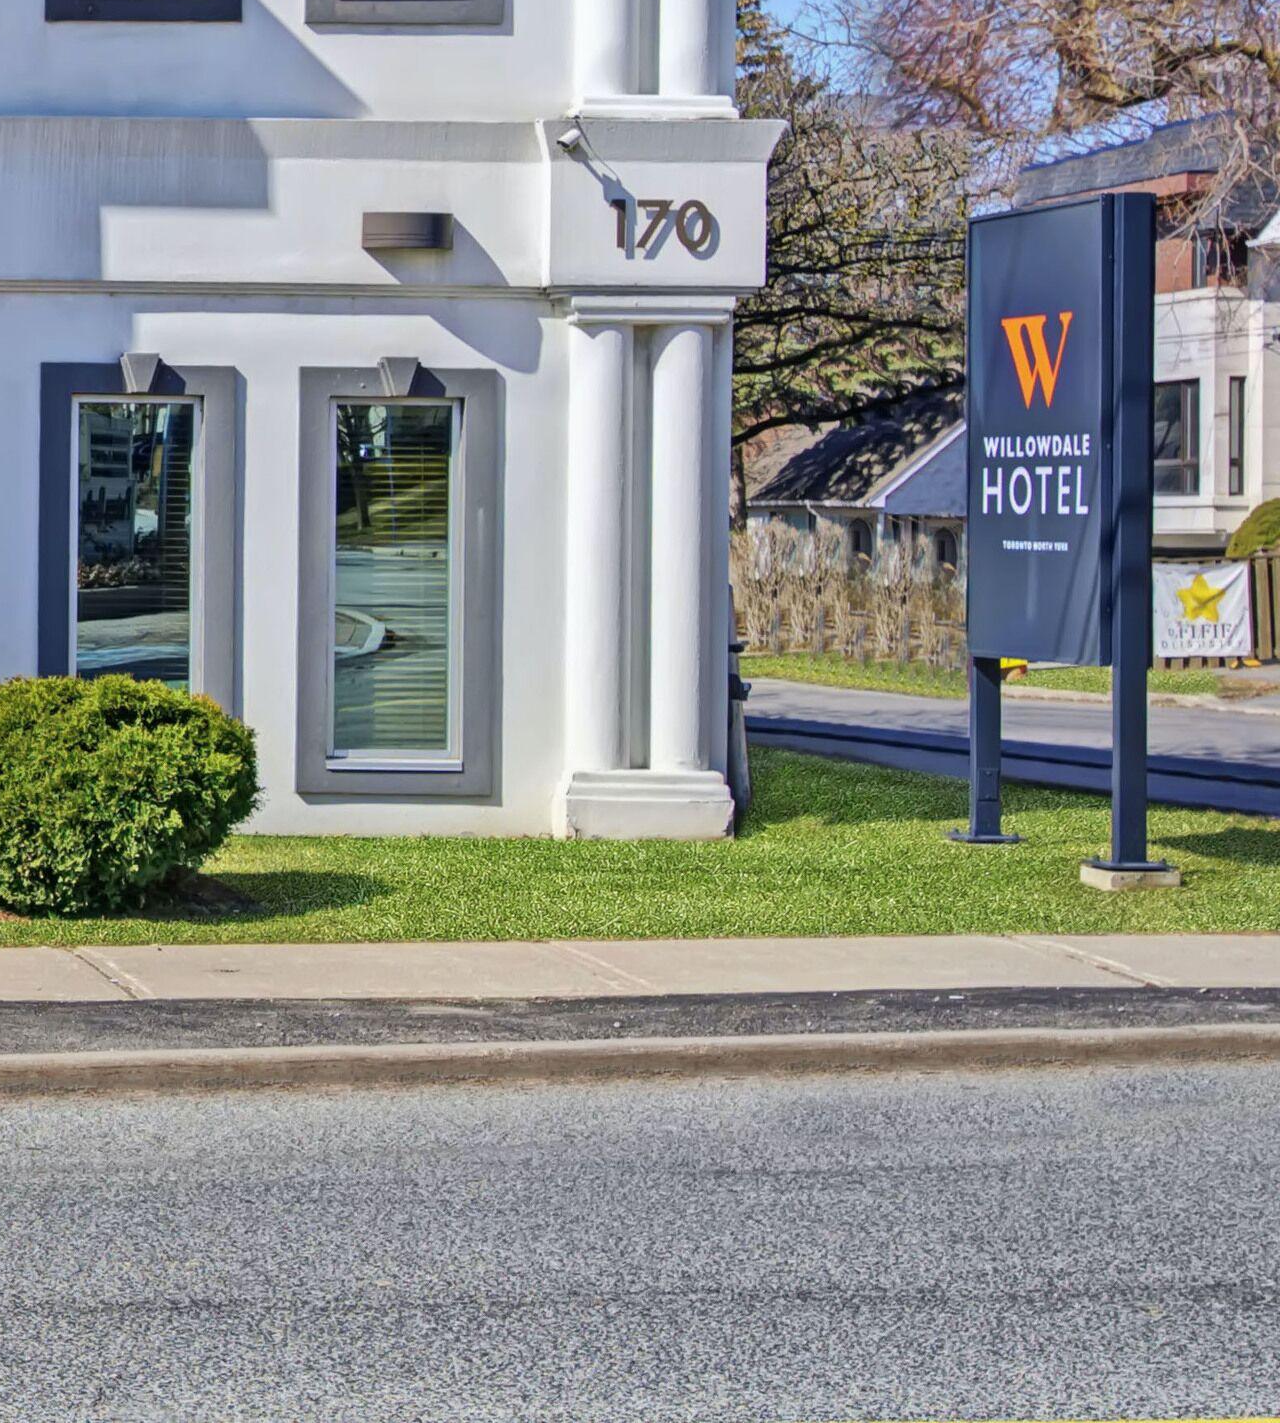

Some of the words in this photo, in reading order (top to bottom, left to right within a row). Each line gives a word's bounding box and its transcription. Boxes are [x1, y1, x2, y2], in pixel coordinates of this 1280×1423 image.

[609, 198, 712, 252] 170
[1001, 311, 1073, 410] W
[983, 433, 1090, 458] WILLOWDALE
[982, 465, 1089, 515] HOTEL
